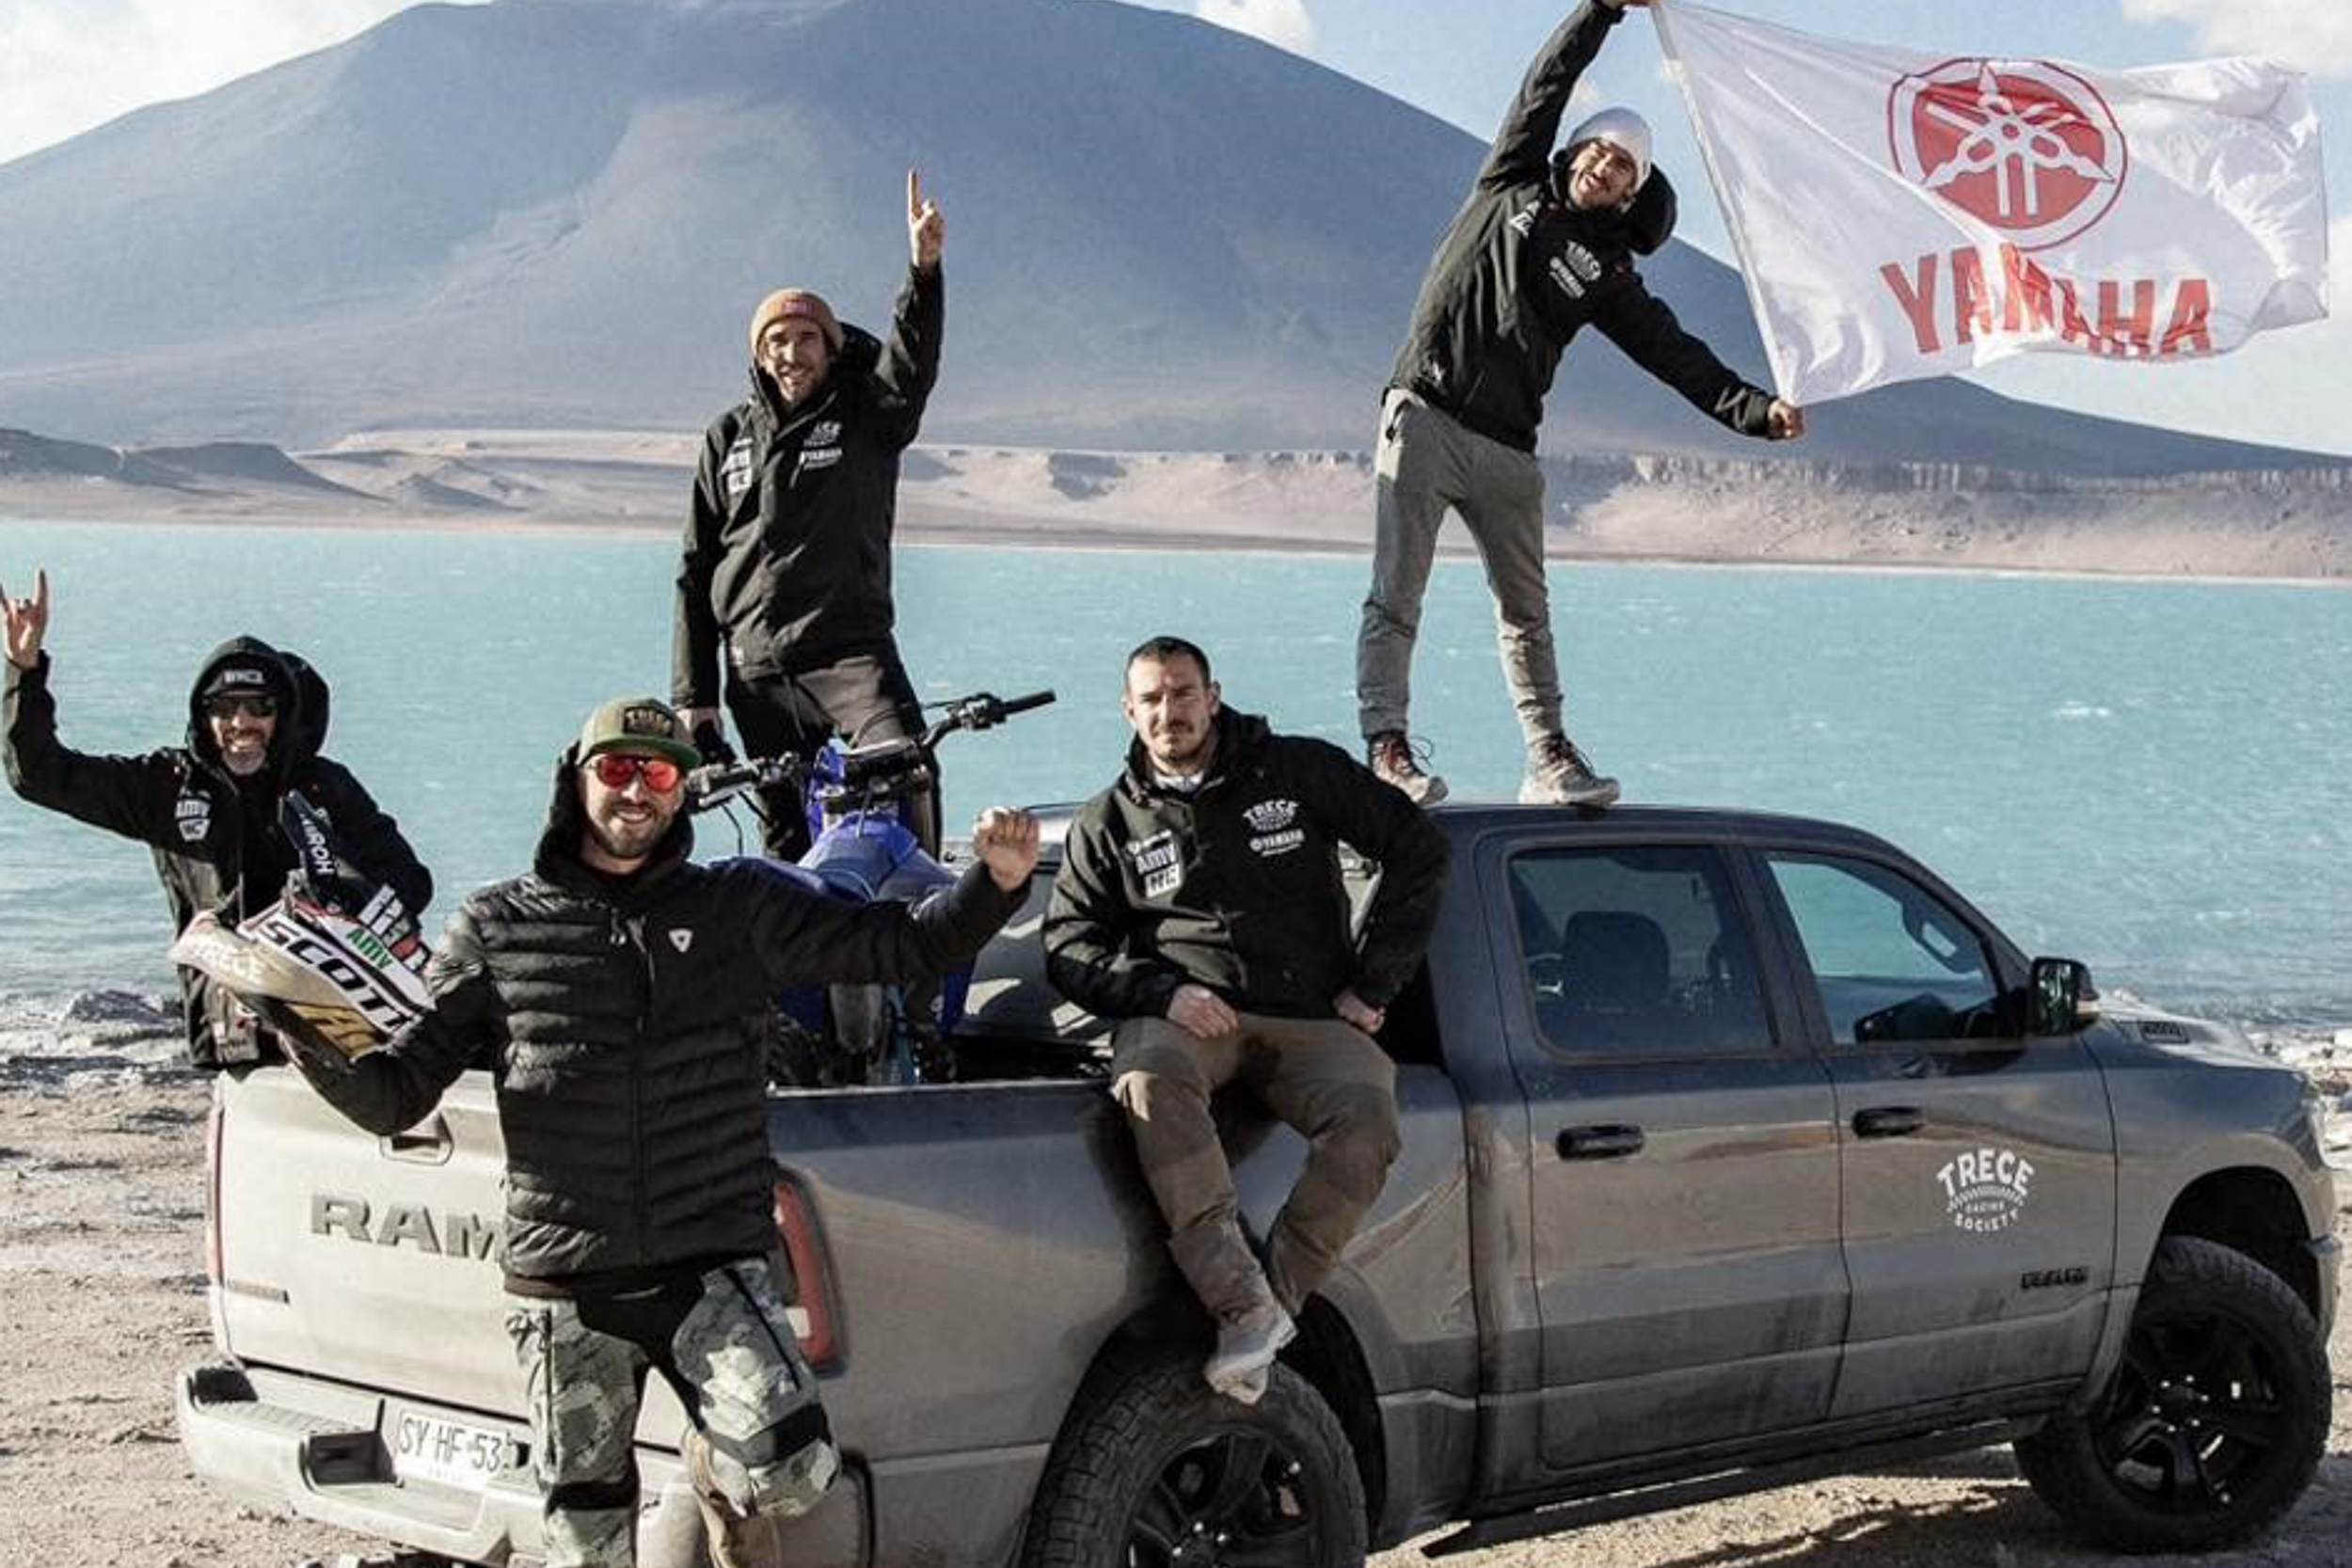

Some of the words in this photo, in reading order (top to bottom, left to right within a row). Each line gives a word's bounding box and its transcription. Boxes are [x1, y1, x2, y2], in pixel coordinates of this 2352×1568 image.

[1880, 242, 2212, 357] YAMAHA
[1243, 798, 1298, 827] TRECE
[1936, 1148, 2036, 1197] TRECE
[311, 1194, 505, 1262] RAM
[1954, 1208, 2019, 1233] SOCIETY
